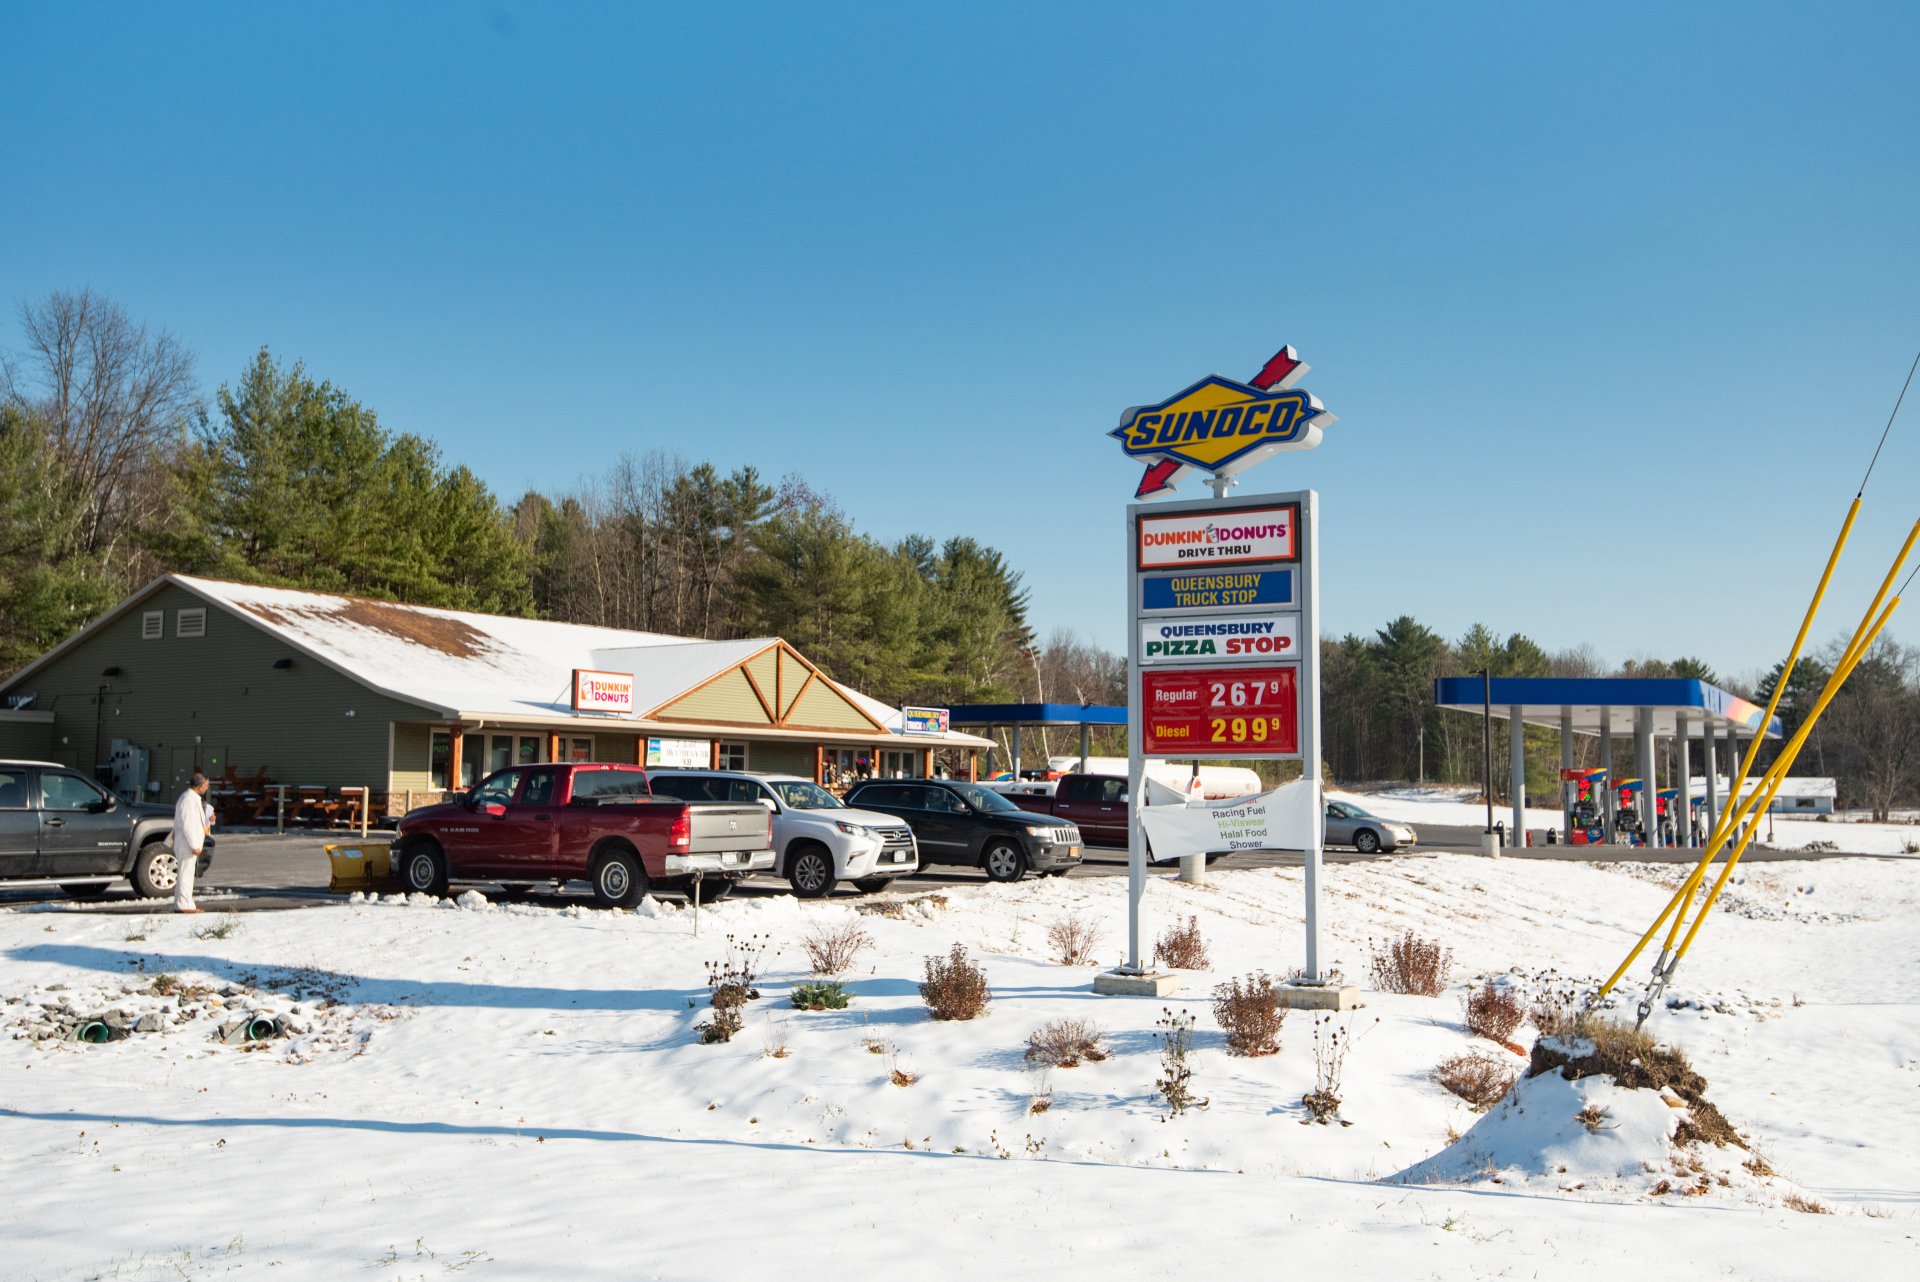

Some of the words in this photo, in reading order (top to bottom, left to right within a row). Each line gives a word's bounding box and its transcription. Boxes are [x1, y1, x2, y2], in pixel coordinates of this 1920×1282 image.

[1131, 400, 1300, 446] SUNOCO
[1144, 530, 1206, 546] DUNKIN'
[1220, 524, 1286, 541] DONUTS
[1178, 547, 1214, 558] DRIVE
[1217, 545, 1251, 555] THRU
[1171, 574, 1261, 591] QUEENSBURY
[1175, 592, 1219, 606] TRUCK
[1222, 590, 1257, 604] STOP
[1160, 622, 1274, 638] QUEENSBURY
[1147, 639, 1216, 656] PIZZA
[1226, 636, 1291, 654] STOP
[595, 681, 631, 693] DUNKIN'
[595, 692, 629, 703] DONUTS
[1155, 689, 1197, 703] Regular
[1156, 725, 1189, 738] Diesel
[1212, 808, 1245, 819] Racing
[1247, 806, 1266, 815] Fuel
[1220, 829, 1243, 839] Halal
[1245, 828, 1267, 838] Food
[1229, 840, 1263, 850] Shower
